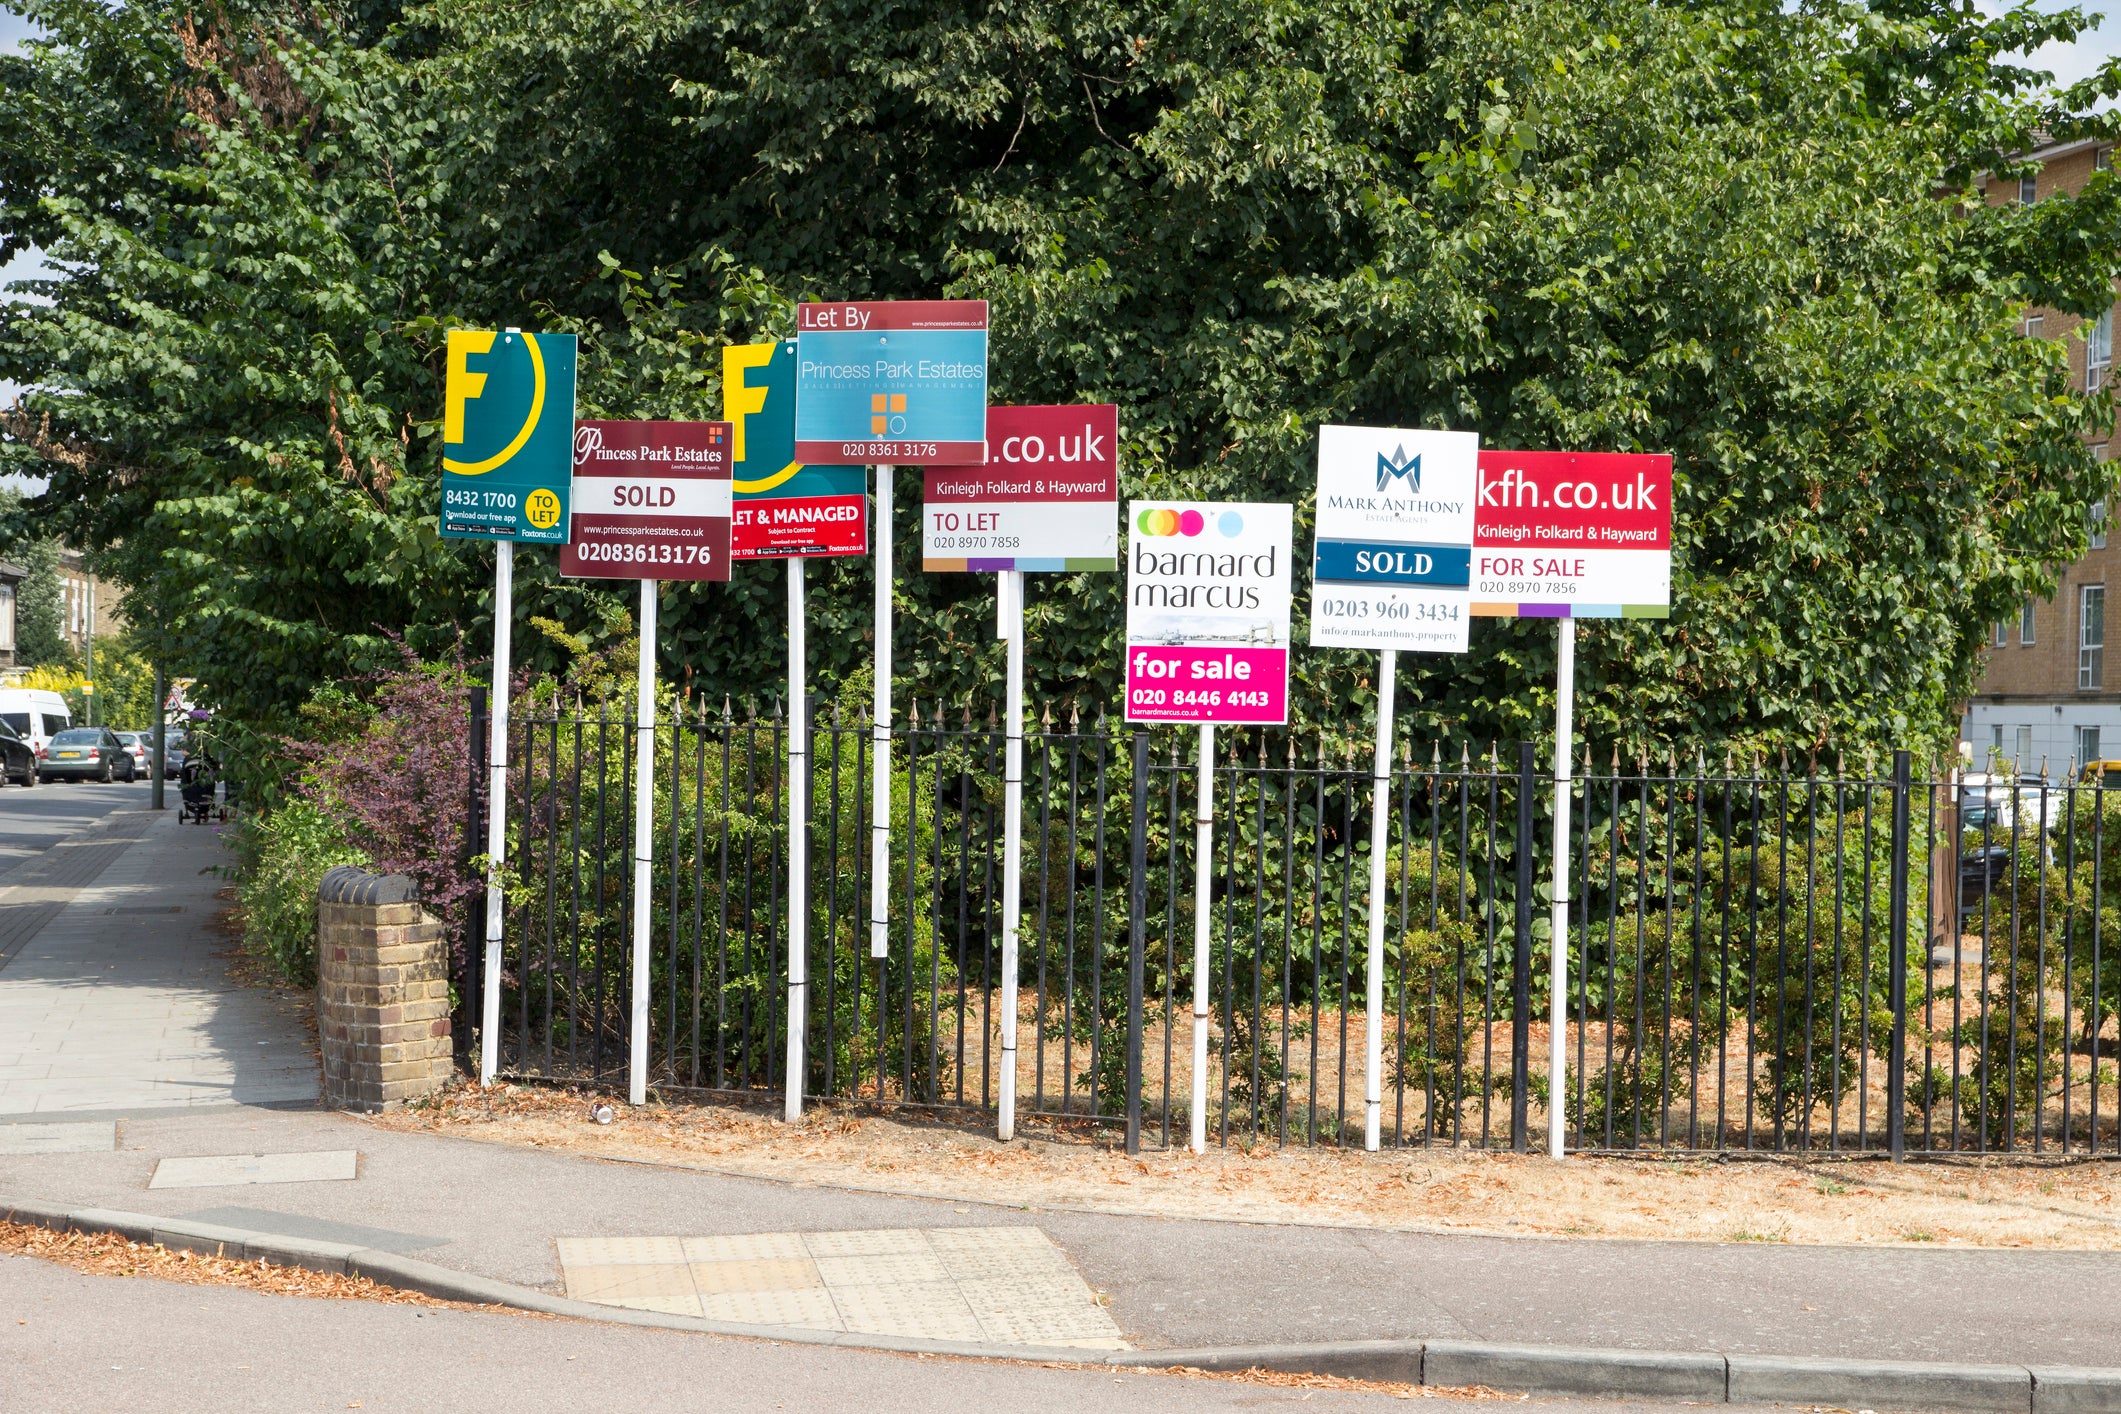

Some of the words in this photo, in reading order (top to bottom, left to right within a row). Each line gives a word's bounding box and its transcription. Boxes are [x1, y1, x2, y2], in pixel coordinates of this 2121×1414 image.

[806, 307, 838, 327] Let
[846, 306, 871, 330] By
[802, 361, 870, 379] Princess
[876, 360, 913, 379] Park
[918, 360, 983, 378] Estates
[444, 331, 498, 444] F
[723, 343, 776, 462] F
[574, 426, 637, 466] Princess
[640, 446, 671, 461] Park
[675, 446, 722, 462] Estates
[842, 444, 865, 456] 020
[869, 444, 899, 456] 8361
[904, 444, 937, 456] 3176
[985, 424, 1106, 463] .co.uk
[613, 486, 676, 507] SOLD
[936, 481, 983, 498] Kinleigh
[987, 480, 1031, 494] Folkard
[1035, 481, 1045, 493] &
[1049, 479, 1106, 496] Hayward
[1478, 469, 1657, 510] kfh.co.uk
[446, 490, 478, 506] 8432
[482, 492, 516, 508] 1700
[534, 496, 553, 508] TO
[1328, 495, 1376, 510] MARK
[1382, 497, 1464, 514] ANTHONY
[446, 510, 476, 520] Download
[489, 513, 502, 521] free
[504, 515, 516, 524] app
[532, 510, 554, 522] LET
[757, 510, 770, 524] &
[774, 506, 858, 524] MANAGED
[933, 513, 959, 532] TO
[967, 513, 1000, 531] LET
[1365, 513, 1393, 522] ESTATE
[522, 529, 563, 539] Foxtons.co.uk
[584, 525, 704, 537] www.princessparkestates.co.uk
[1477, 524, 1530, 541] Kinleigh
[1535, 525, 1583, 540] Folkard
[1587, 528, 1597, 540] &
[1601, 528, 1657, 543] Hayward
[934, 537, 955, 548] 020
[958, 537, 986, 548] 8970
[991, 536, 1020, 548] 7858
[578, 542, 710, 564] 02083613176
[1136, 542, 1275, 578] barnard
[1356, 550, 1433, 575] SOLD
[1480, 558, 1524, 576] FOR
[1533, 559, 1585, 577] SALE
[1135, 584, 1260, 609] marcus
[1480, 582, 1504, 593] 020
[1508, 582, 1540, 593] 8970
[1546, 582, 1576, 594] 7856
[1323, 598, 1368, 617] 0203
[1376, 601, 1409, 620] 960
[1415, 603, 1458, 621] 3434
[1321, 626, 1457, 642] info@markanthony.property
[1133, 652, 1181, 678] for
[1191, 654, 1251, 680] sale
[1132, 689, 1166, 705] 020
[1173, 690, 1221, 706] 8446
[1227, 691, 1269, 707] 4143
[1132, 708, 1199, 717] barnardmarcus.co.uk
